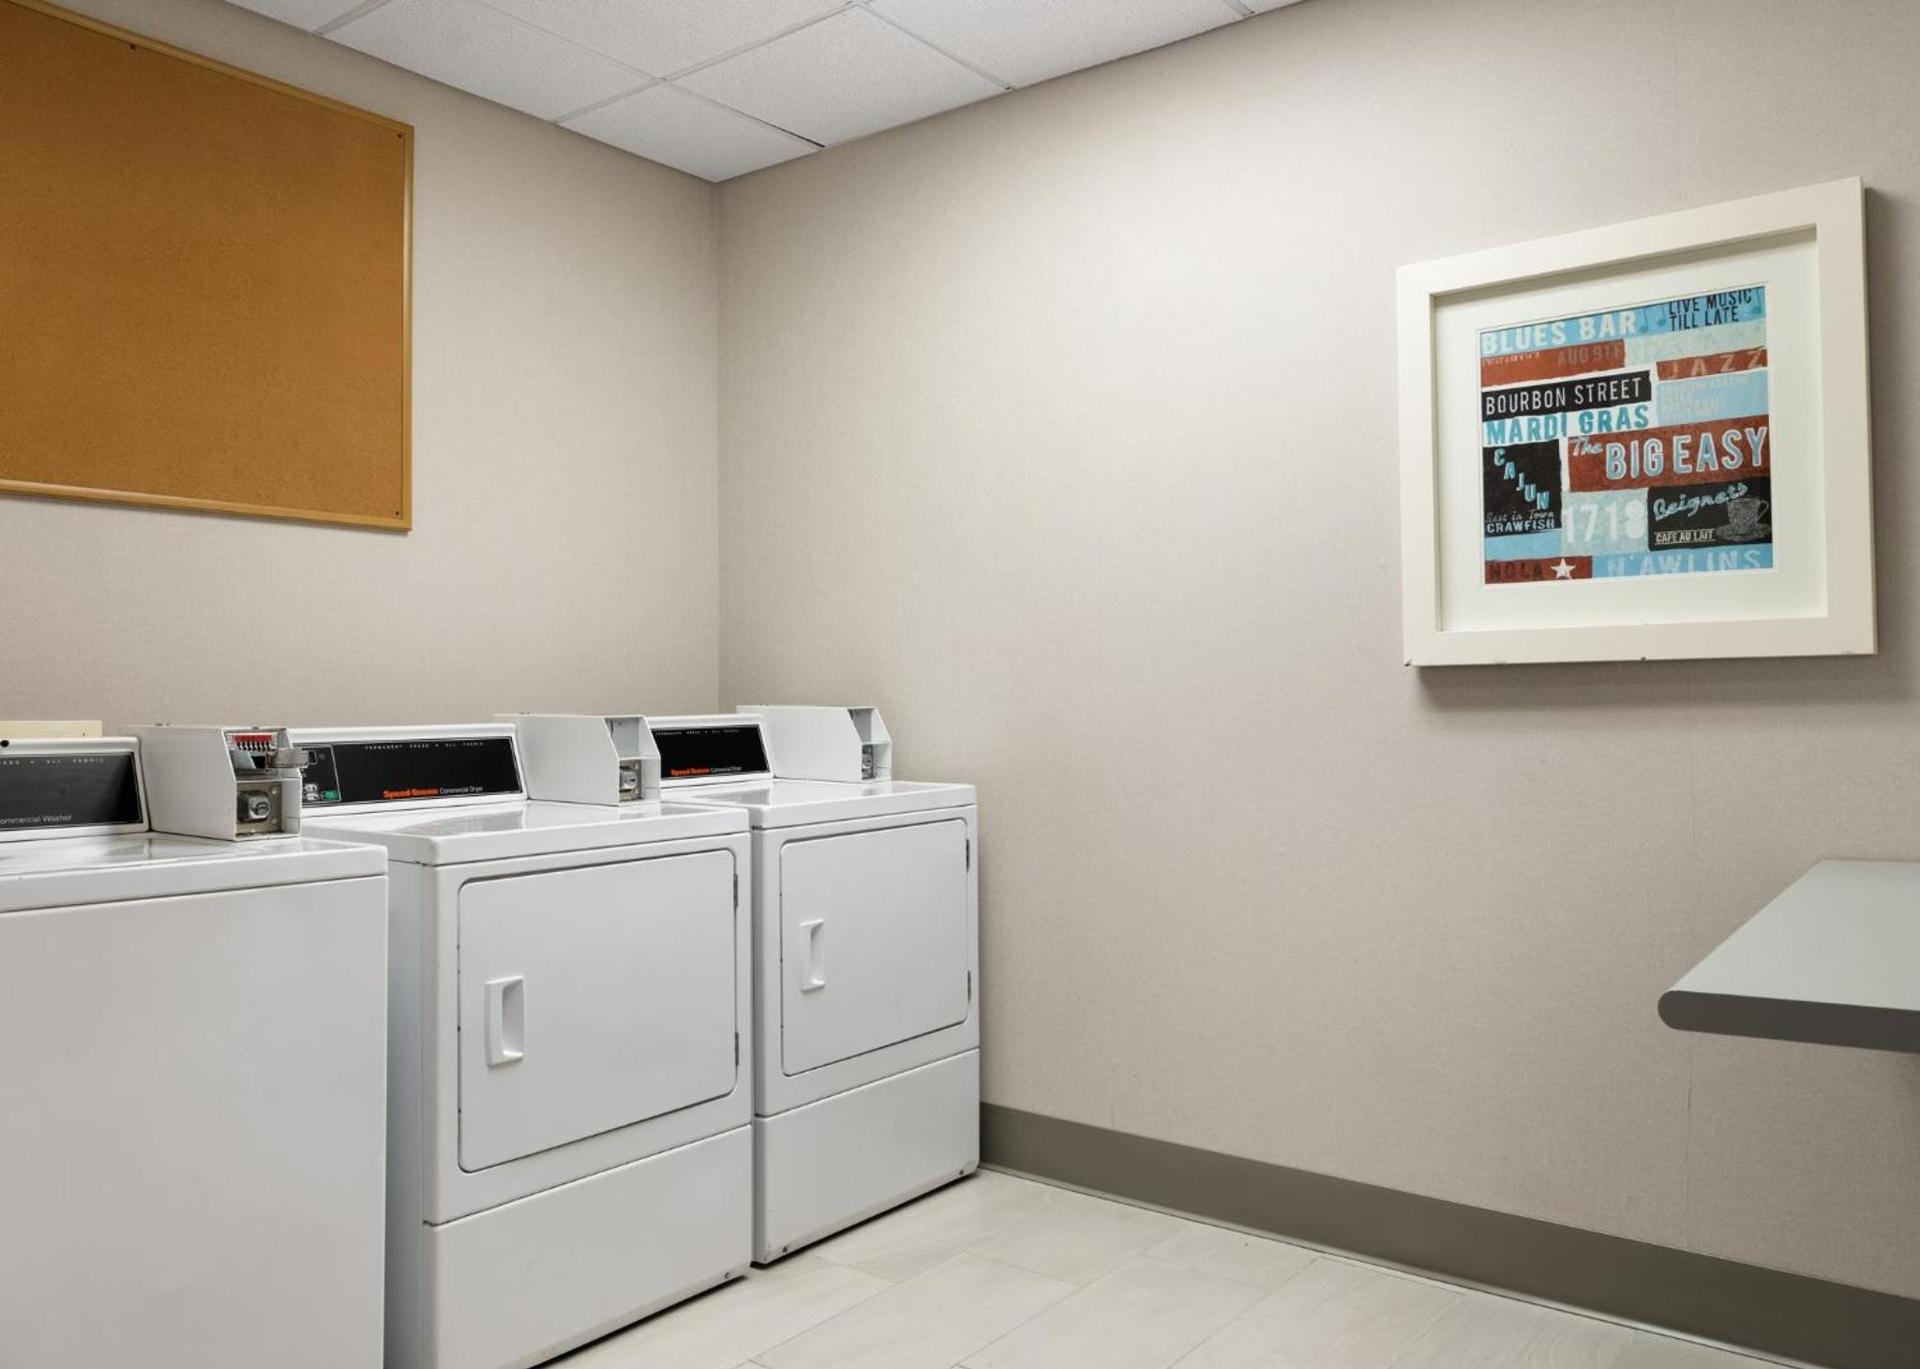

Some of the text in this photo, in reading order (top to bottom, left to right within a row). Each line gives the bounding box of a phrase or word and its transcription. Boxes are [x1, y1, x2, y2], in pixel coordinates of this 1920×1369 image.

[1668, 289, 1753, 316] LIVE MUSIC
[1670, 304, 1739, 332] TILL LATE
[1482, 310, 1638, 356] BLUES BAR
[1486, 387, 1567, 415] BOURBON
[1574, 377, 1643, 405] STREET
[1486, 405, 1650, 446] MARDI GRAS
[1571, 426, 1768, 481] The BIG EASY
[1493, 448, 1550, 510] CAJUN
[1486, 519, 1556, 534] CRAWFISH
